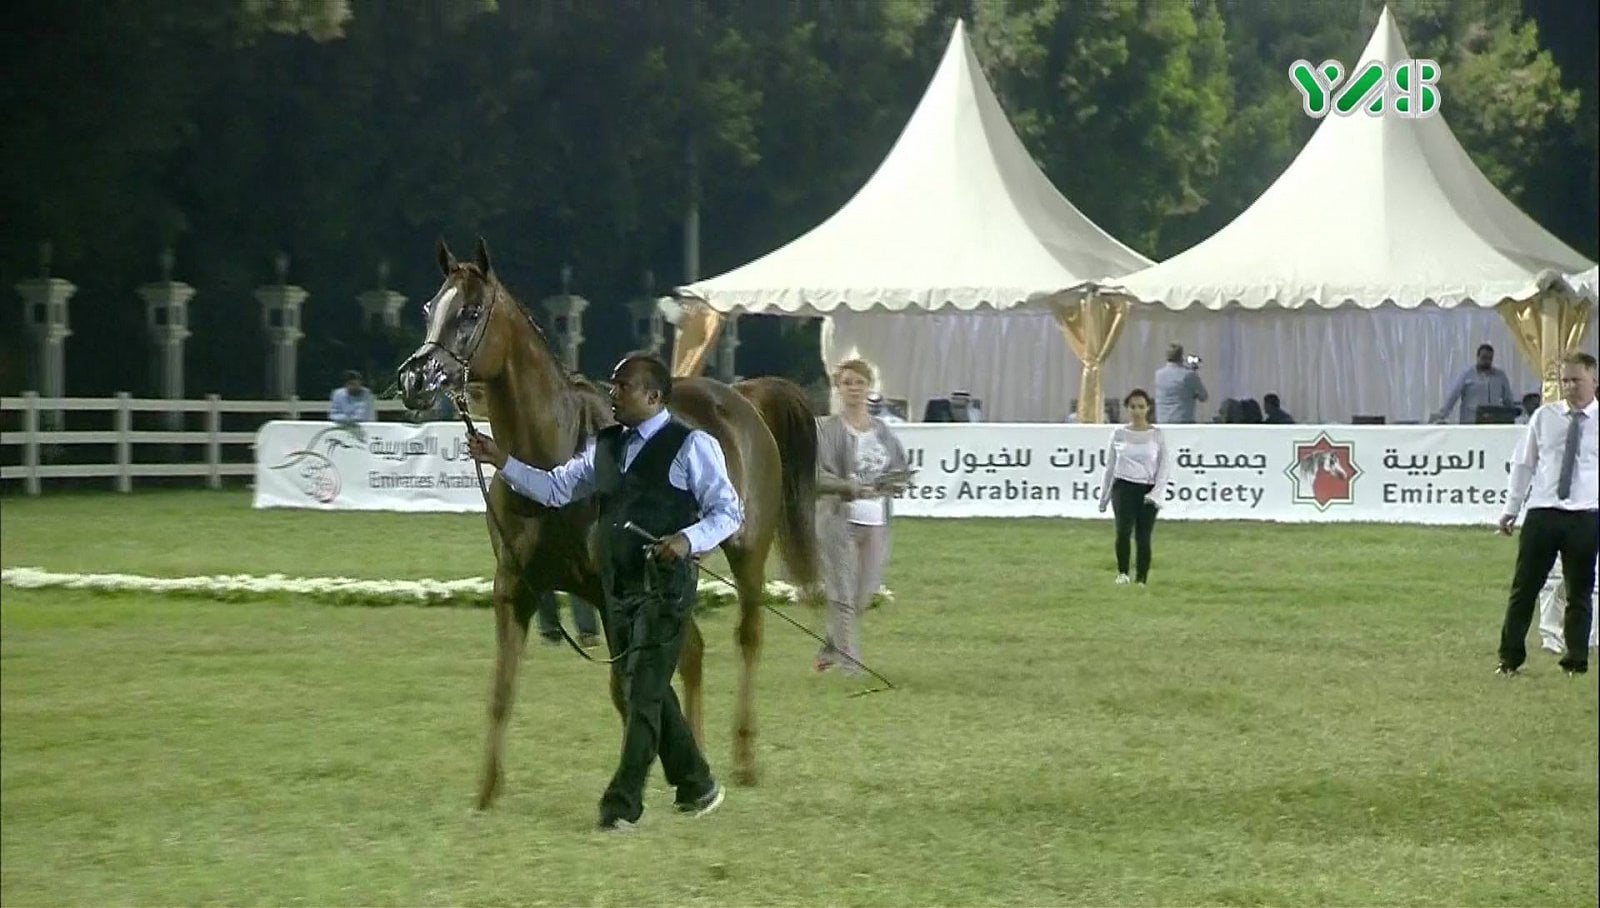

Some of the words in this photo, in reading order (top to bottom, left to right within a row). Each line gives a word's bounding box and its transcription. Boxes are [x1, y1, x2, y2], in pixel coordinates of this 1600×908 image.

[940, 447, 1031, 474] للخيول
[1177, 448, 1266, 474] جمعية
[1383, 449, 1484, 476] العربية
[369, 470, 435, 488] Emirates
[957, 480, 1060, 500] Arabian
[1165, 481, 1264, 508] Society
